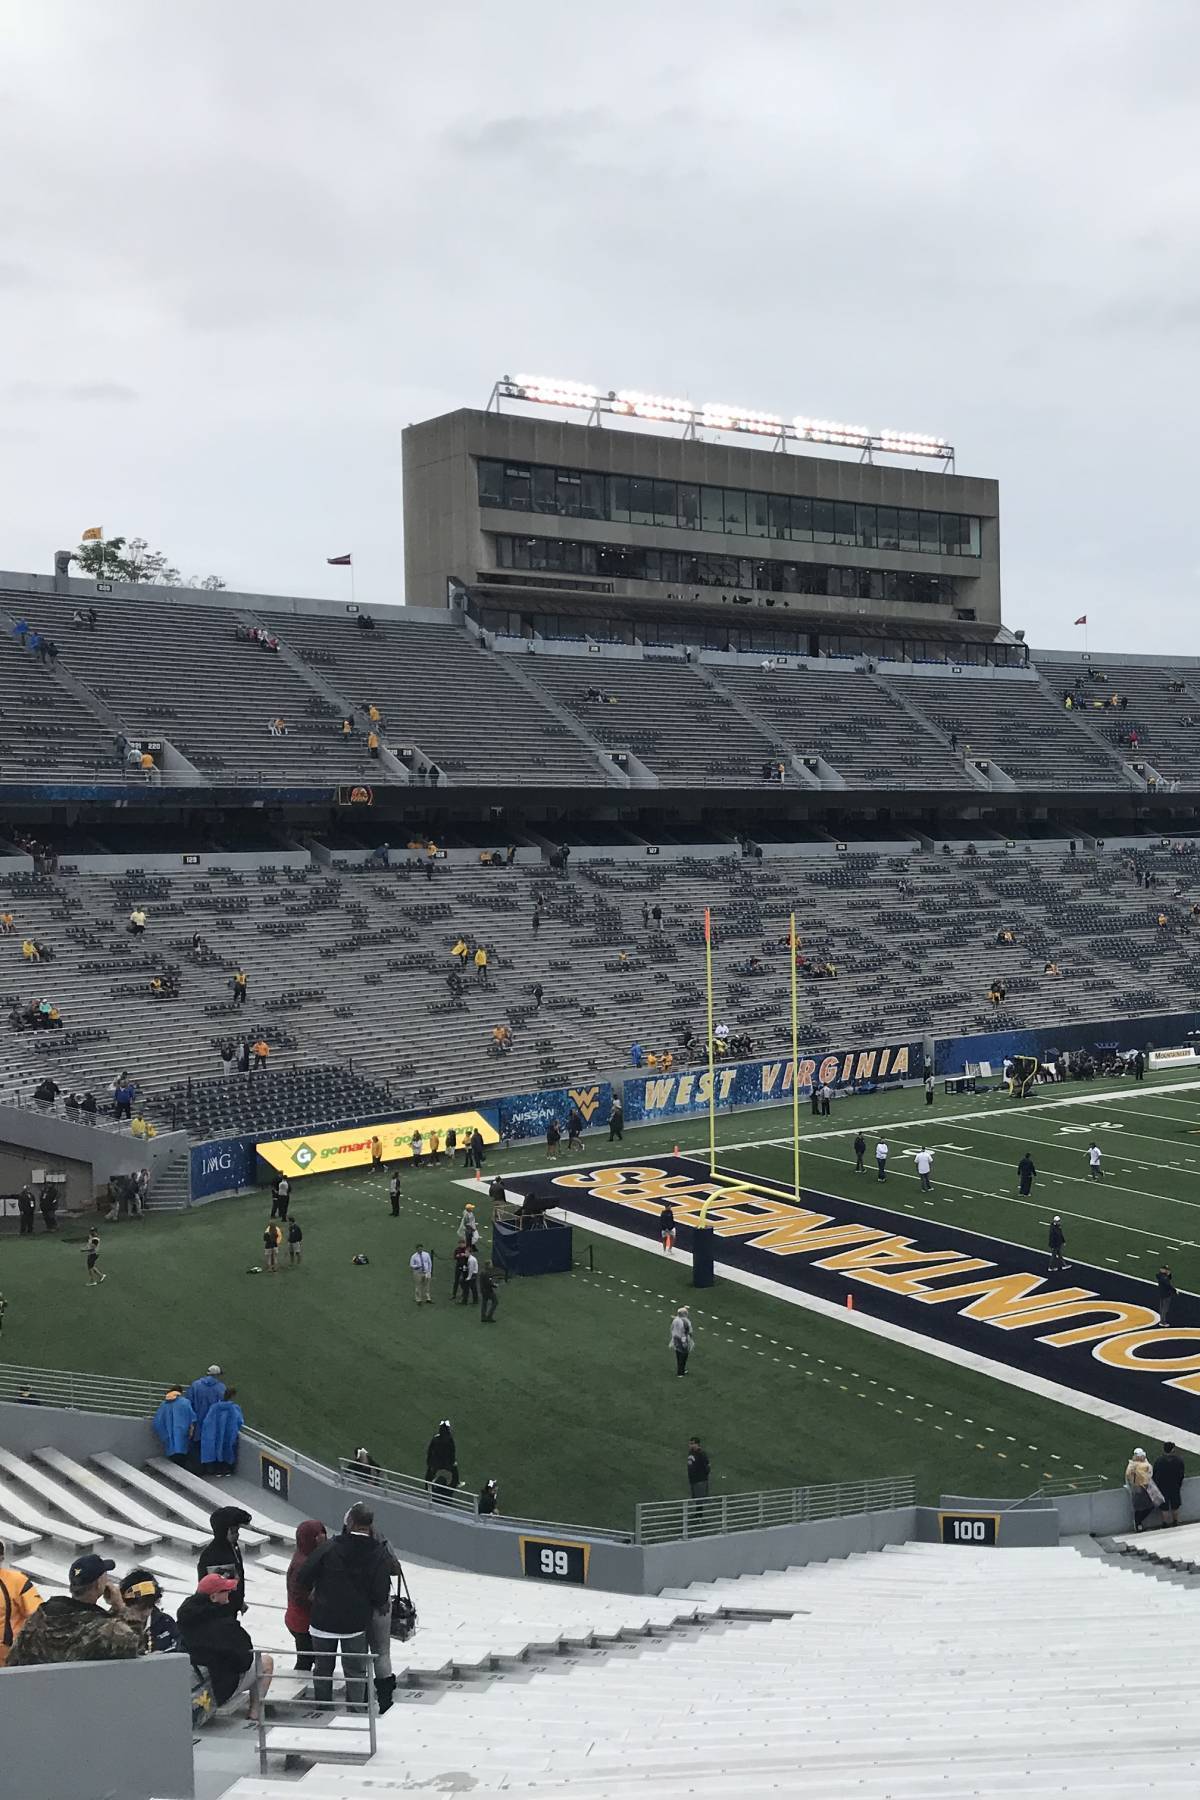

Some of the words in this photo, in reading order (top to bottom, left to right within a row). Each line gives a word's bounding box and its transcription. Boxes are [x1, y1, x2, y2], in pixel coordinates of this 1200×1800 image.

[645, 1069, 737, 1110] WEST
[762, 1047, 909, 1094] VIRGINIA
[511, 1108, 555, 1122] NISSAN
[320, 1139, 373, 1158] gomart
[202, 1153, 231, 1176] IMG
[269, 1465, 280, 1490] 98
[953, 1521, 985, 1540] 100
[540, 1549, 568, 1575] 99
